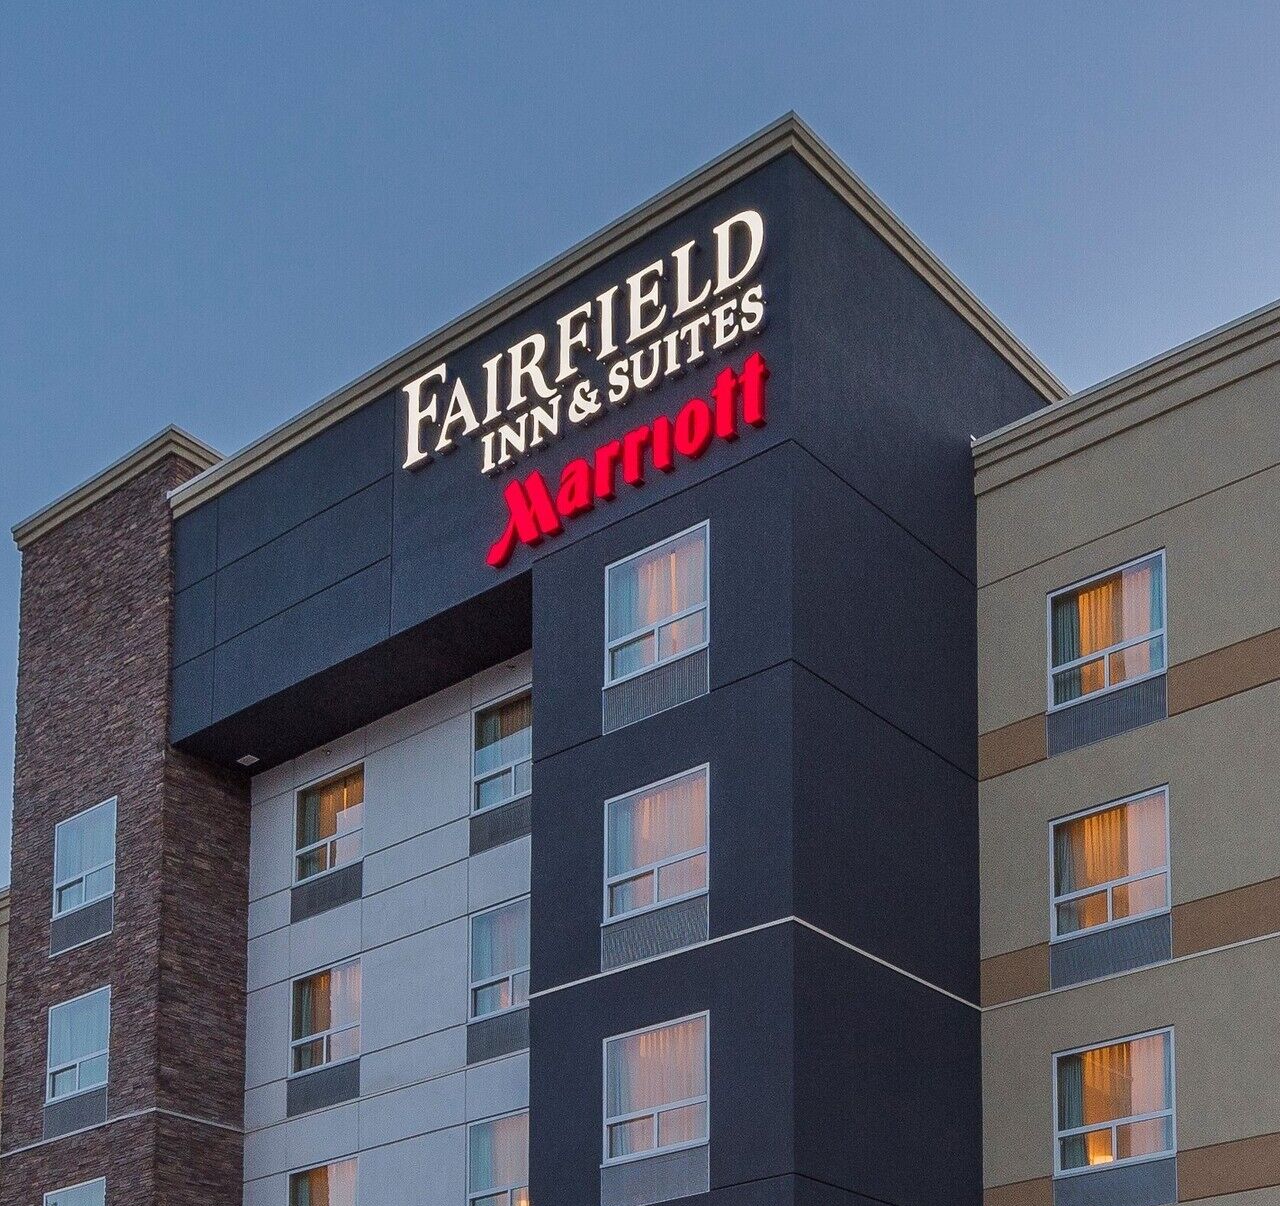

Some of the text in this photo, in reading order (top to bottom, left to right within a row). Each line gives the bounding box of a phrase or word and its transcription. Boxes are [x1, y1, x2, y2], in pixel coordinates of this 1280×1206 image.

[402, 209, 766, 470] FAIRFIELD
[481, 284, 766, 475] INN & SUITES
[485, 351, 770, 568] Marriott
